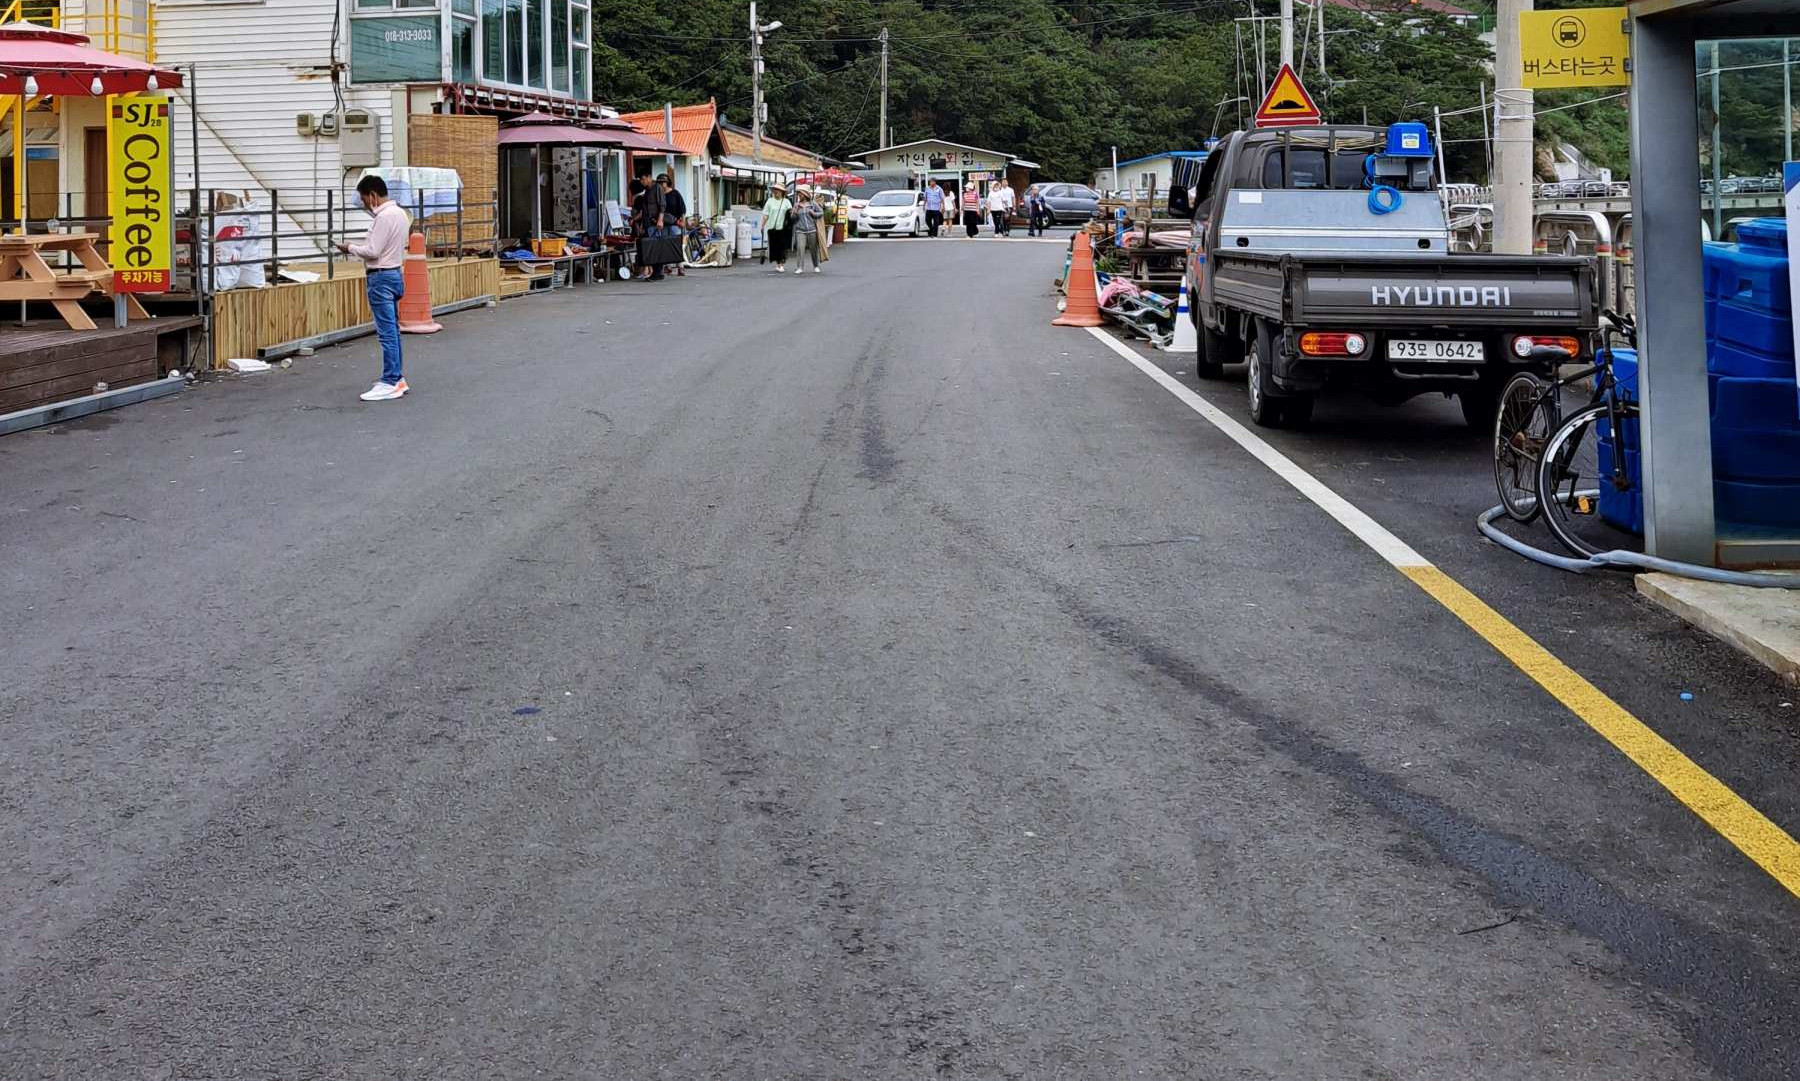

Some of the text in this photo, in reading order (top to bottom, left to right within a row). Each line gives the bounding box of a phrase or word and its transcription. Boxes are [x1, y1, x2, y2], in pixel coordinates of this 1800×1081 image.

[1523, 56, 1616, 77] 버스타는곳
[124, 133, 161, 267] Coffee
[1371, 286, 1511, 306] HYUNDAI
[1397, 342, 1475, 358] 93모 0642
